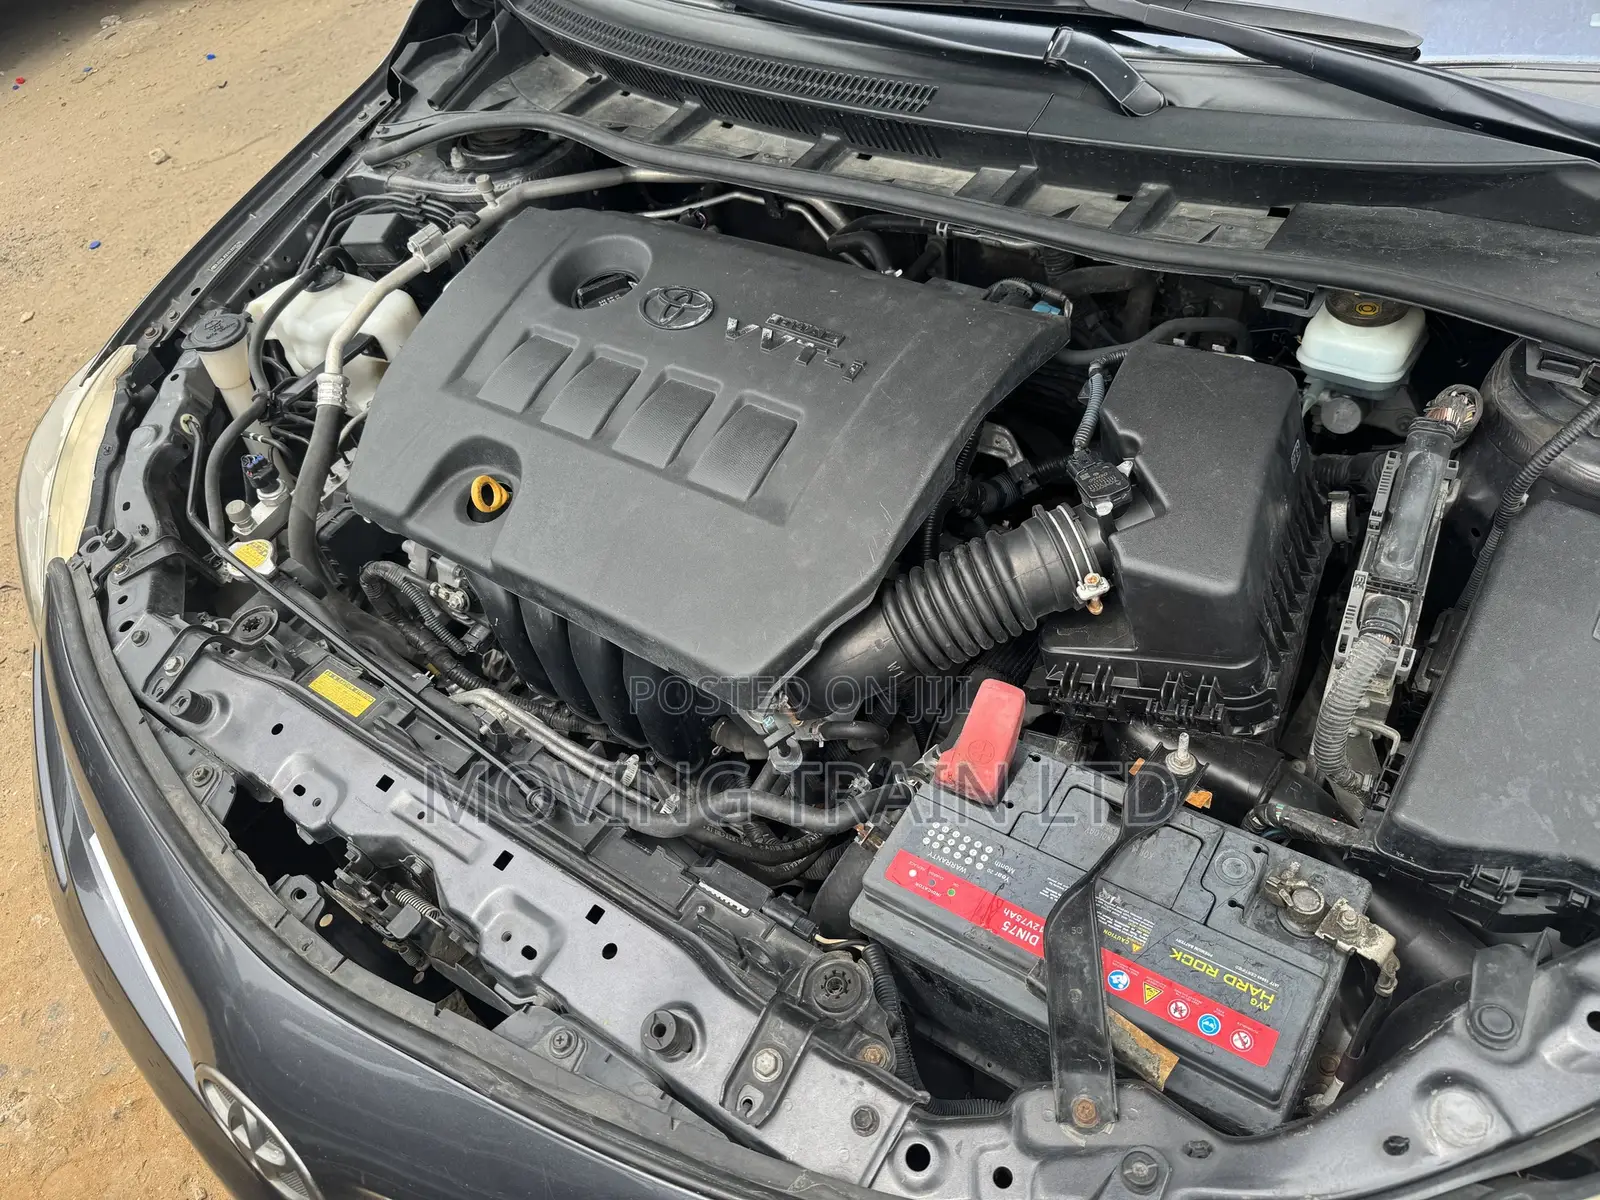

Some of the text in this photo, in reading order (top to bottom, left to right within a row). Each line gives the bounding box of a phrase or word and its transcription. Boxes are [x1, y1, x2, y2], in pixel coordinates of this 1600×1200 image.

[928, 851, 967, 874] WARRANTY
[994, 861, 1016, 874] Month
[1001, 920, 1039, 946] DIN75
[1102, 928, 1129, 945] CAUTION
[1169, 947, 1219, 978] ROCK
[1223, 973, 1274, 1003] HARD
[1250, 997, 1271, 1011] AYG
